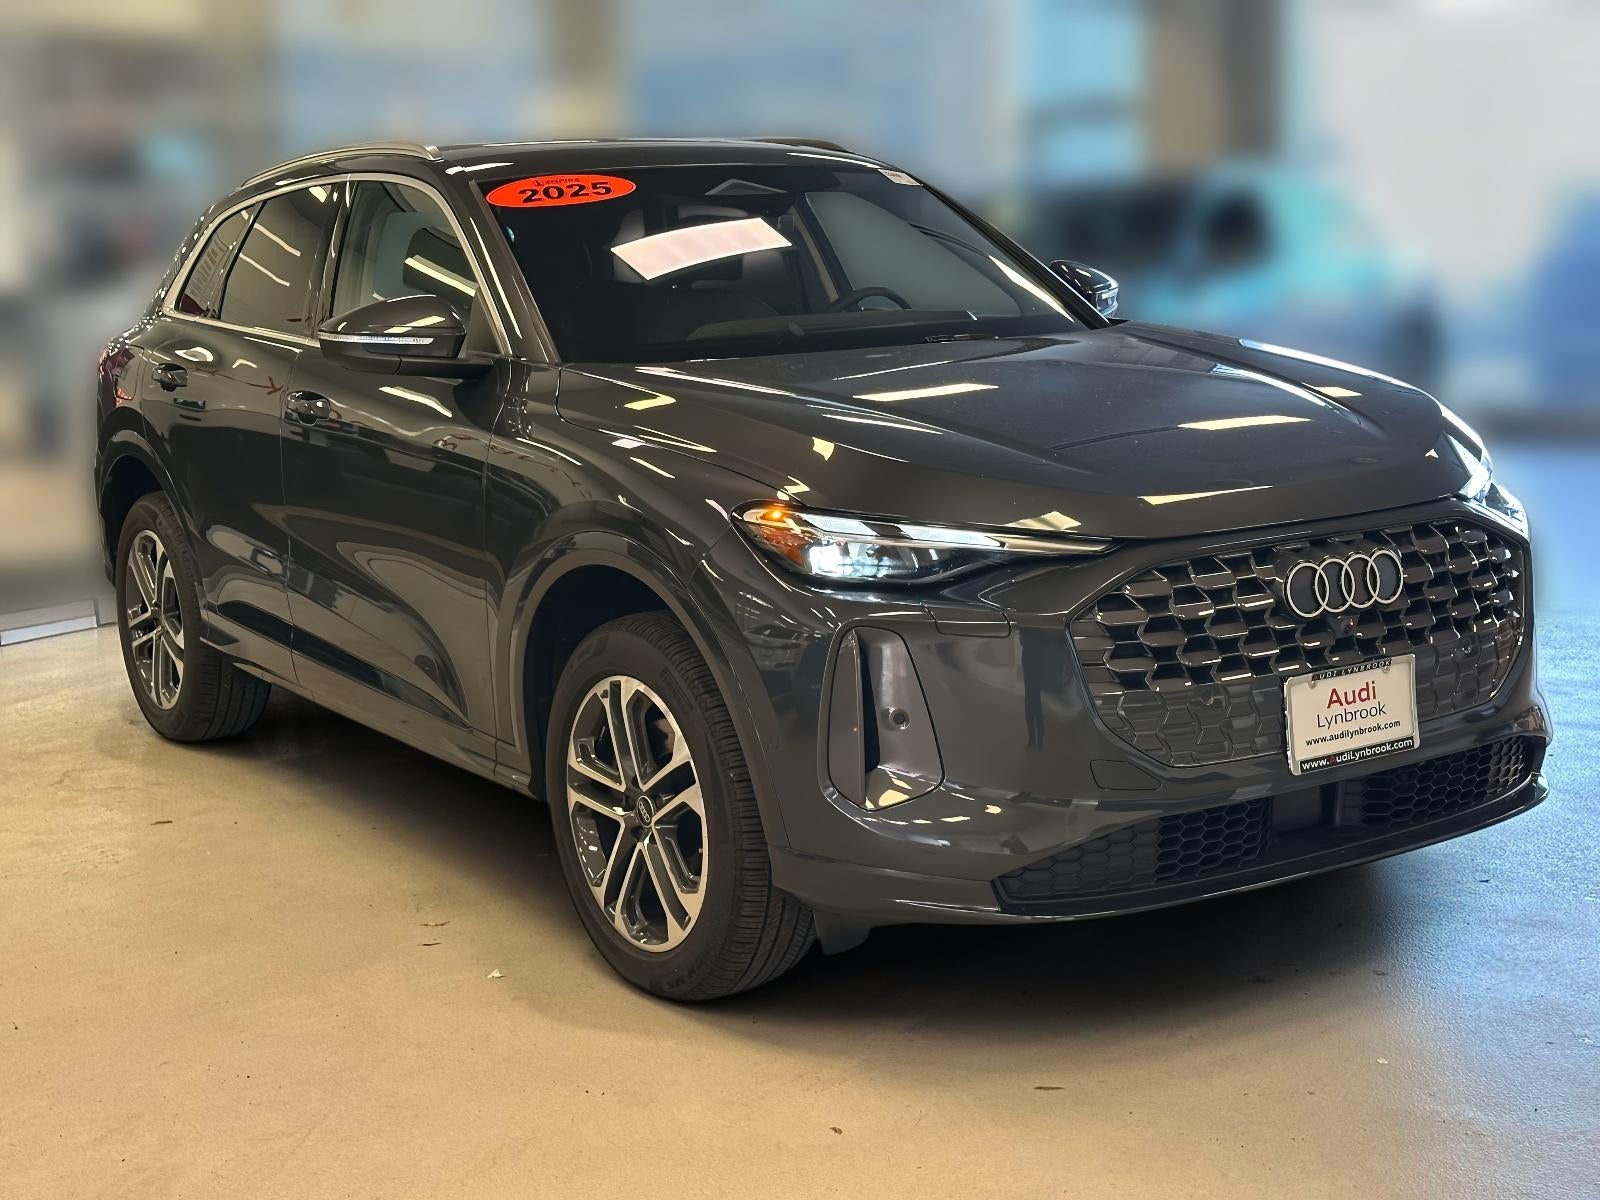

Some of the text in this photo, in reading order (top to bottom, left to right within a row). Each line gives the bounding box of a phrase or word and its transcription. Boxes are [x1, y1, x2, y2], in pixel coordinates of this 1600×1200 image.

[518, 182, 612, 203] 2025
[1341, 659, 1391, 675] LYNBROOK
[1327, 680, 1376, 709] Audi
[1317, 701, 1386, 729] Lynbrook
[1306, 720, 1401, 746] www.audilynbrook.com
[1301, 739, 1413, 770] www.AudiLynbrook.com
